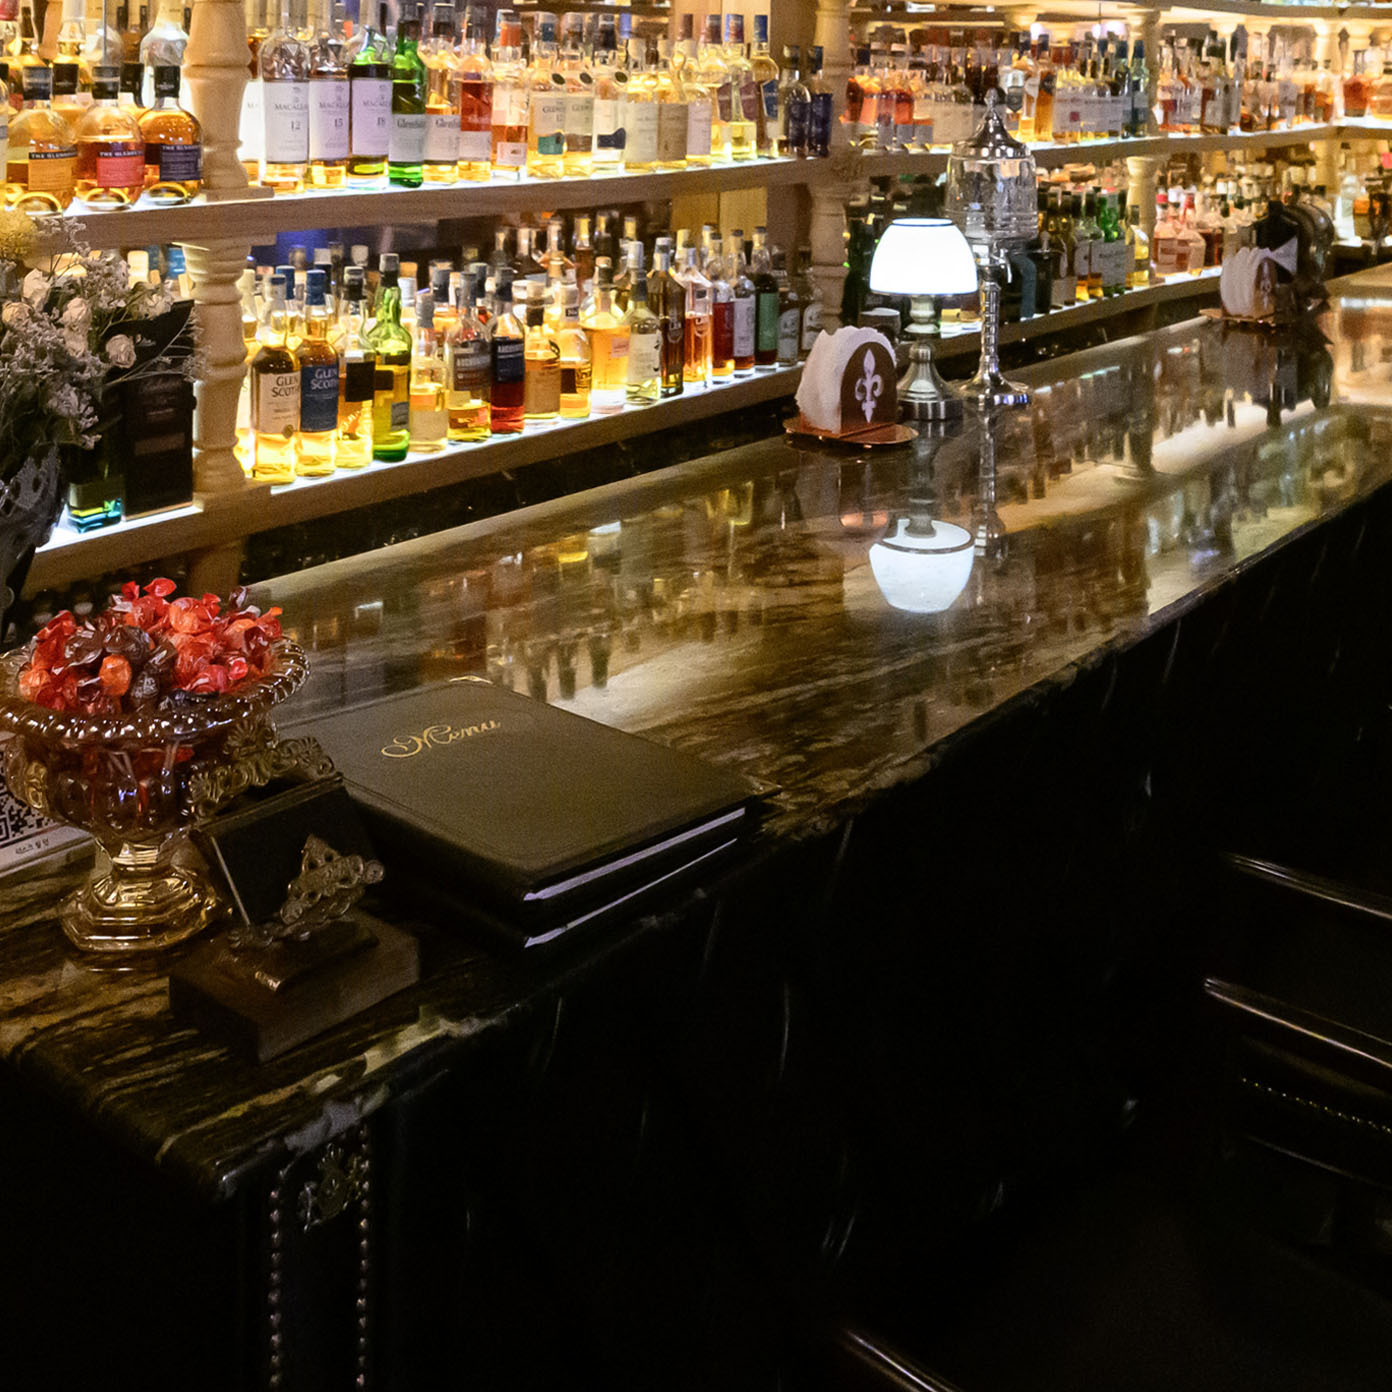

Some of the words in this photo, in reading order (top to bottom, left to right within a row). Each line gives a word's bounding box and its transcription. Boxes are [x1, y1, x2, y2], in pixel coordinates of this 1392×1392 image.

[291, 121, 301, 130] 12
[334, 119, 344, 128] 15
[381, 720, 501, 758] Menu
